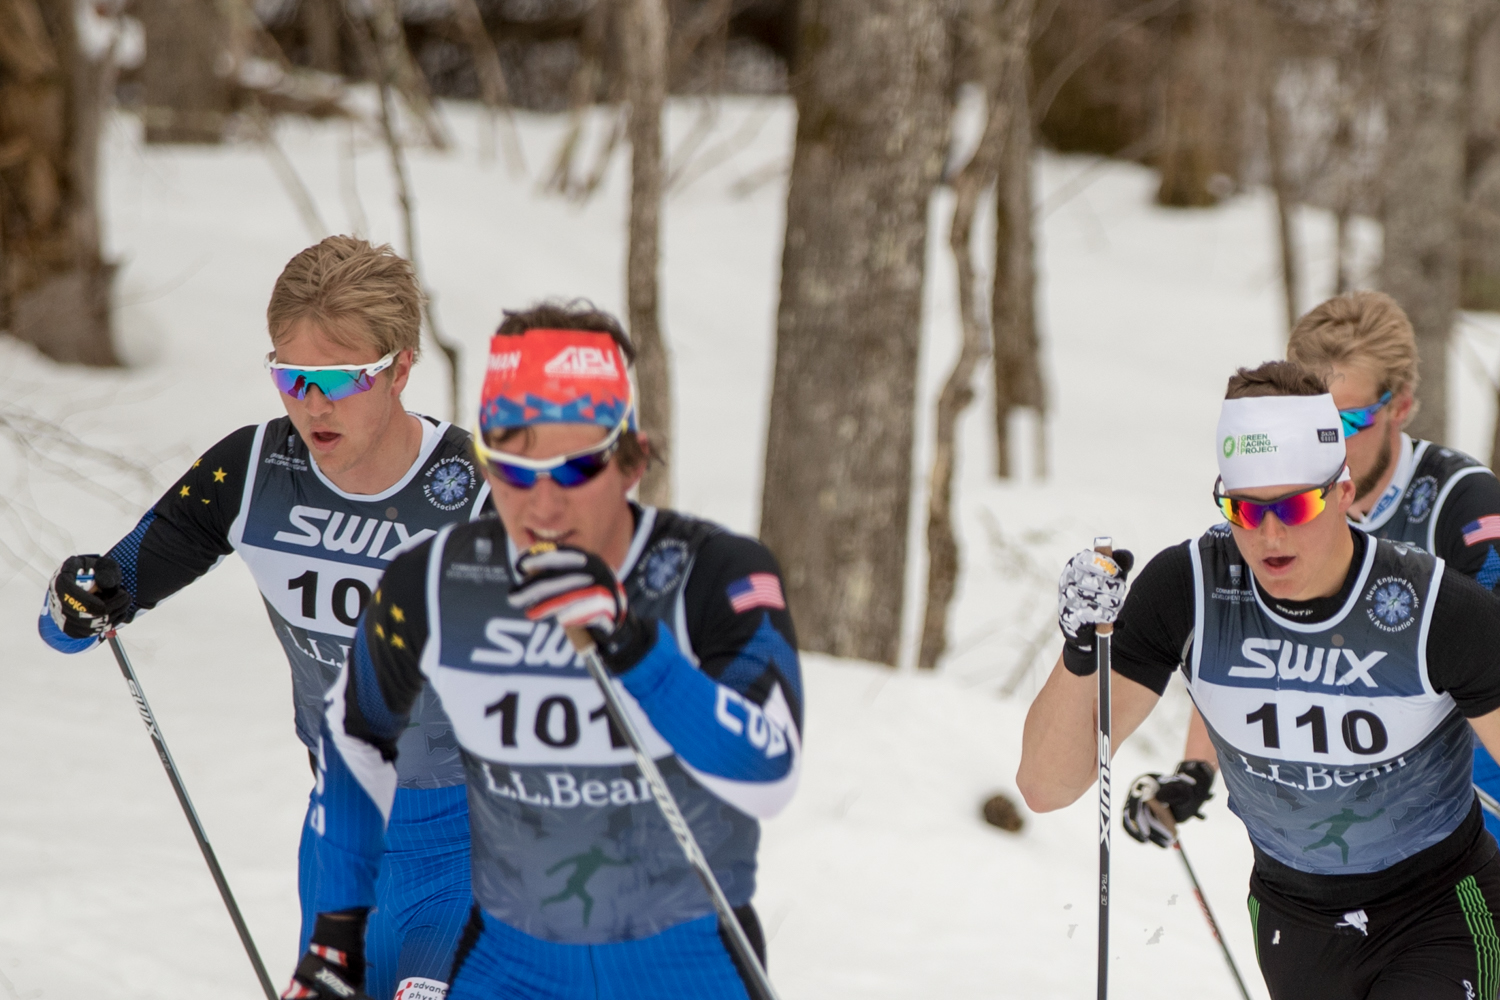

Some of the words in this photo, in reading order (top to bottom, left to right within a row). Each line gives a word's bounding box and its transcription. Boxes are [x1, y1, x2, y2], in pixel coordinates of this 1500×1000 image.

[1241, 440, 1271, 448] RACING
[1241, 446, 1278, 455] PROJECT
[425, 465, 437, 478] New
[423, 484, 432, 499] Ski
[427, 494, 469, 511] Association
[287, 570, 373, 628] 10
[1366, 585, 1378, 602] New
[1377, 575, 1408, 586] England
[1406, 578, 1420, 609] Nordic
[1366, 608, 1375, 626] Ski
[1373, 616, 1416, 633] Association
[1228, 638, 1388, 687] SWIX
[484, 691, 629, 751] 101
[1246, 702, 1389, 756] 110
[413, 981, 447, 997] advanc
